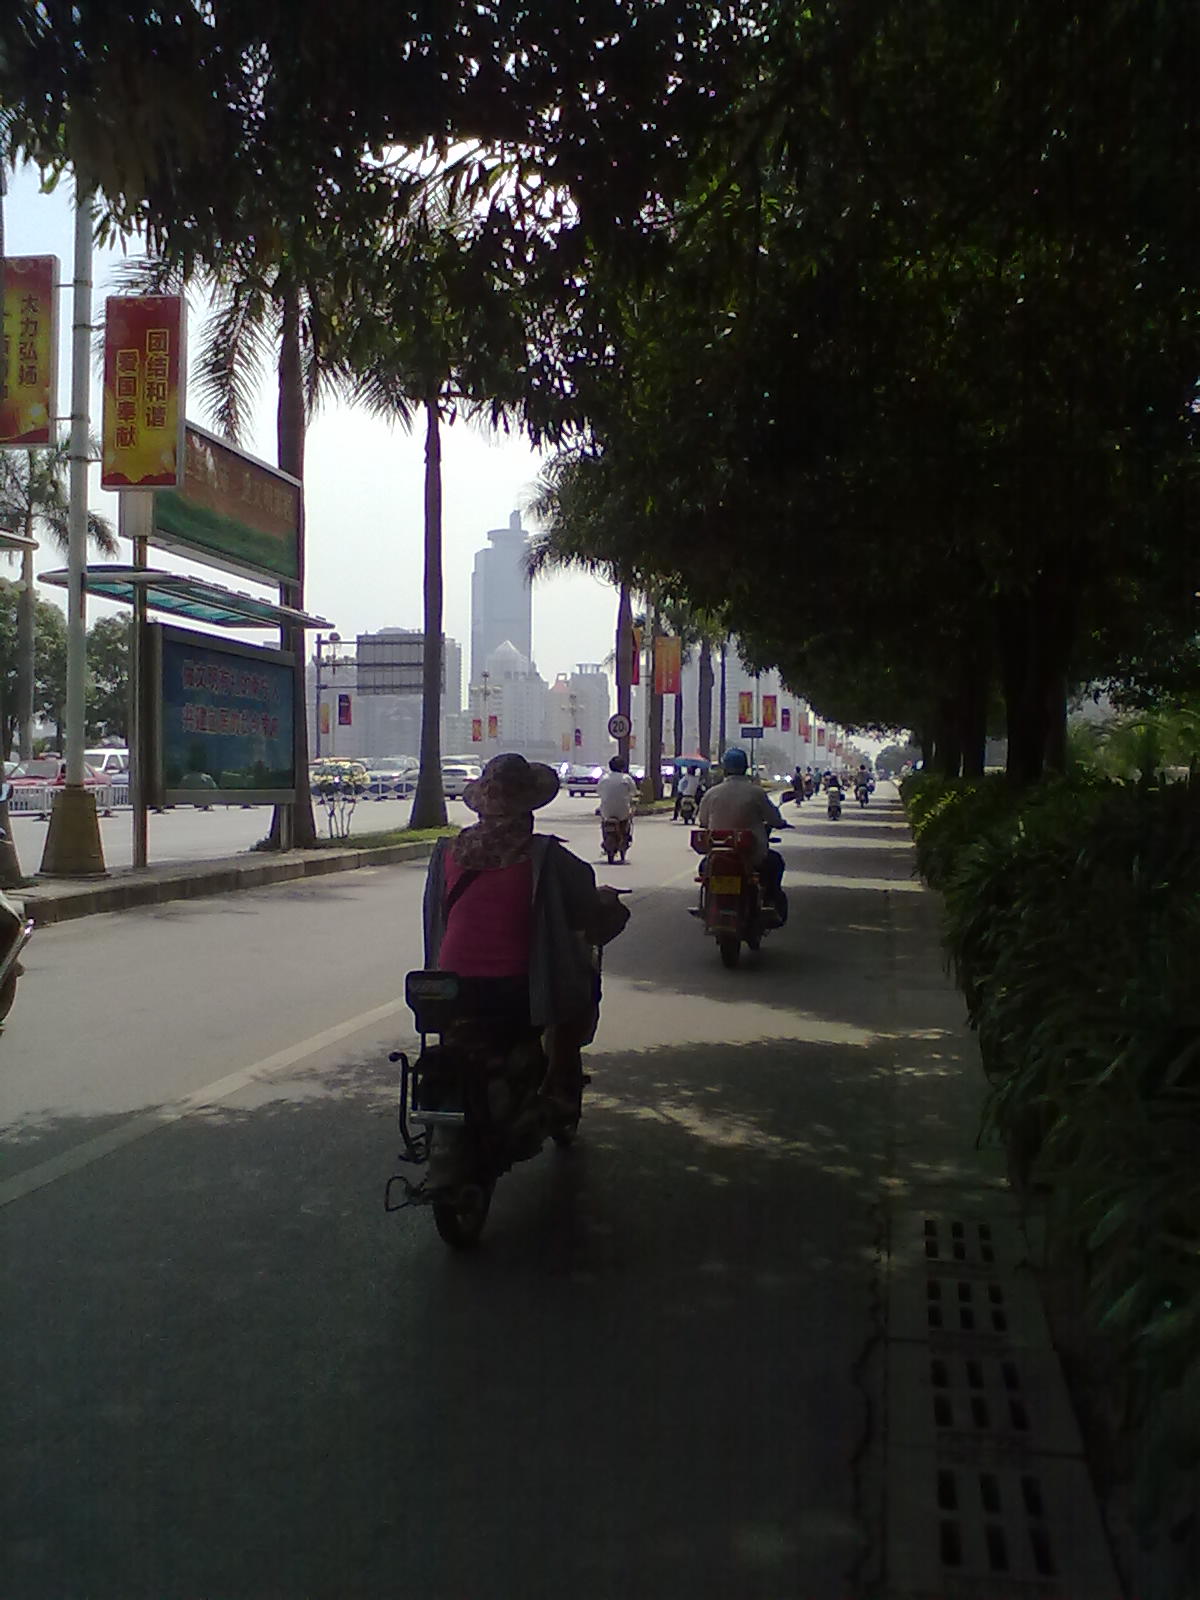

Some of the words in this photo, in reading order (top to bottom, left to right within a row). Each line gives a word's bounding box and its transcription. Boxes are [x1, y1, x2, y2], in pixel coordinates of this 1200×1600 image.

[115, 349, 139, 448] 爱国奉献
[146, 329, 169, 428] 团结和谐
